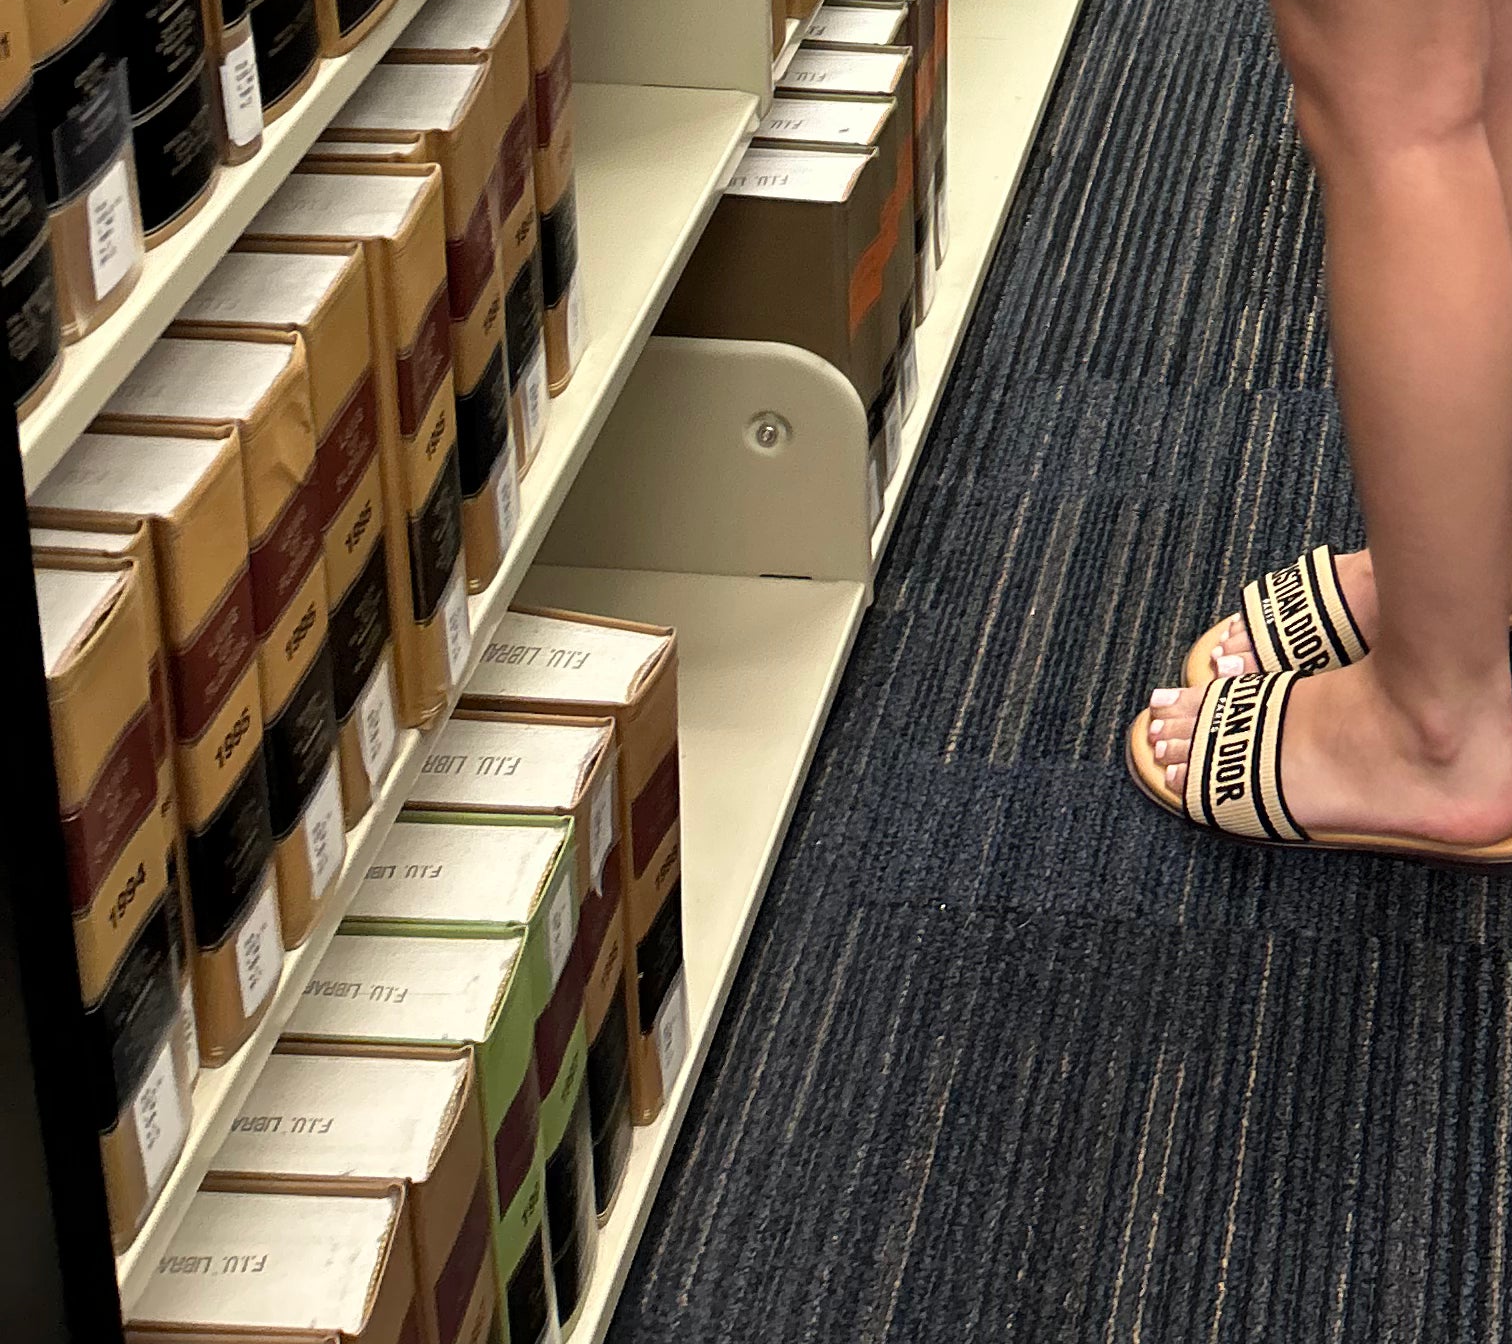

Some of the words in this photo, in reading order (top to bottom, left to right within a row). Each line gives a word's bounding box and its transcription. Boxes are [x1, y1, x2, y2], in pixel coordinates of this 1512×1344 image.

[1262, 598, 1275, 624] PARIS
[1271, 562, 1309, 622] ISTIAN
[1284, 619, 1331, 678] DIOR
[1211, 696, 1227, 733] PARIS
[1216, 739, 1250, 806] DIOR
